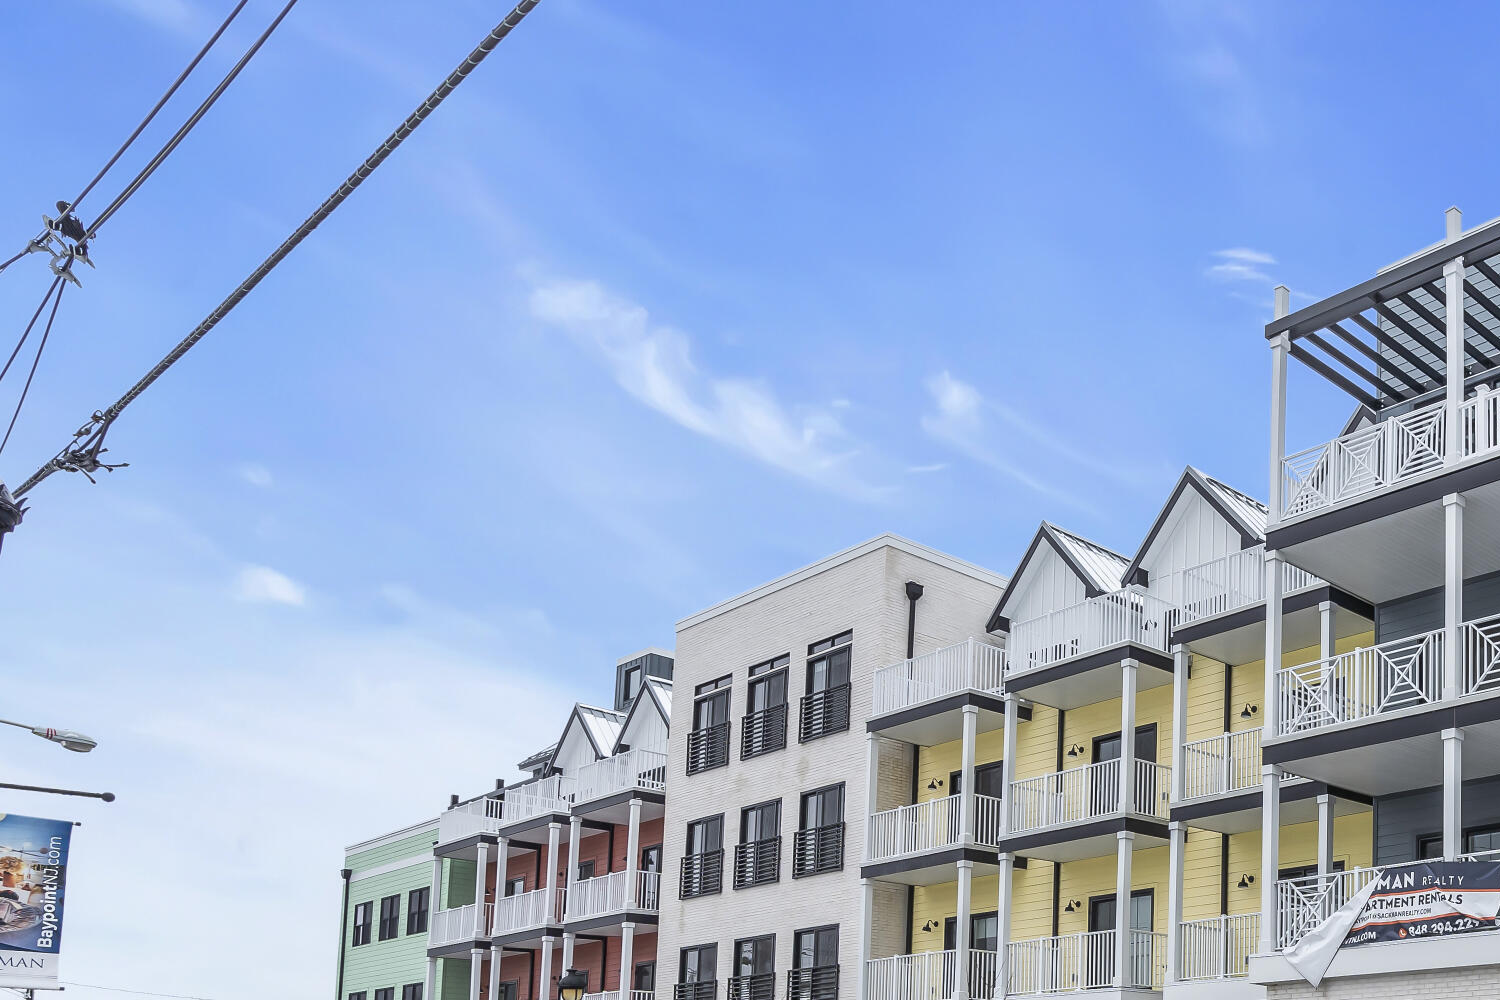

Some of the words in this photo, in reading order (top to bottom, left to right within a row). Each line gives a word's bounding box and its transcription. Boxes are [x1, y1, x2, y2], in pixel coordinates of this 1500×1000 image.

[1422, 875, 1464, 886] REALTY
[37, 836, 63, 948] BaypointNJ.com
[1418, 891, 1463, 906] RENTALS
